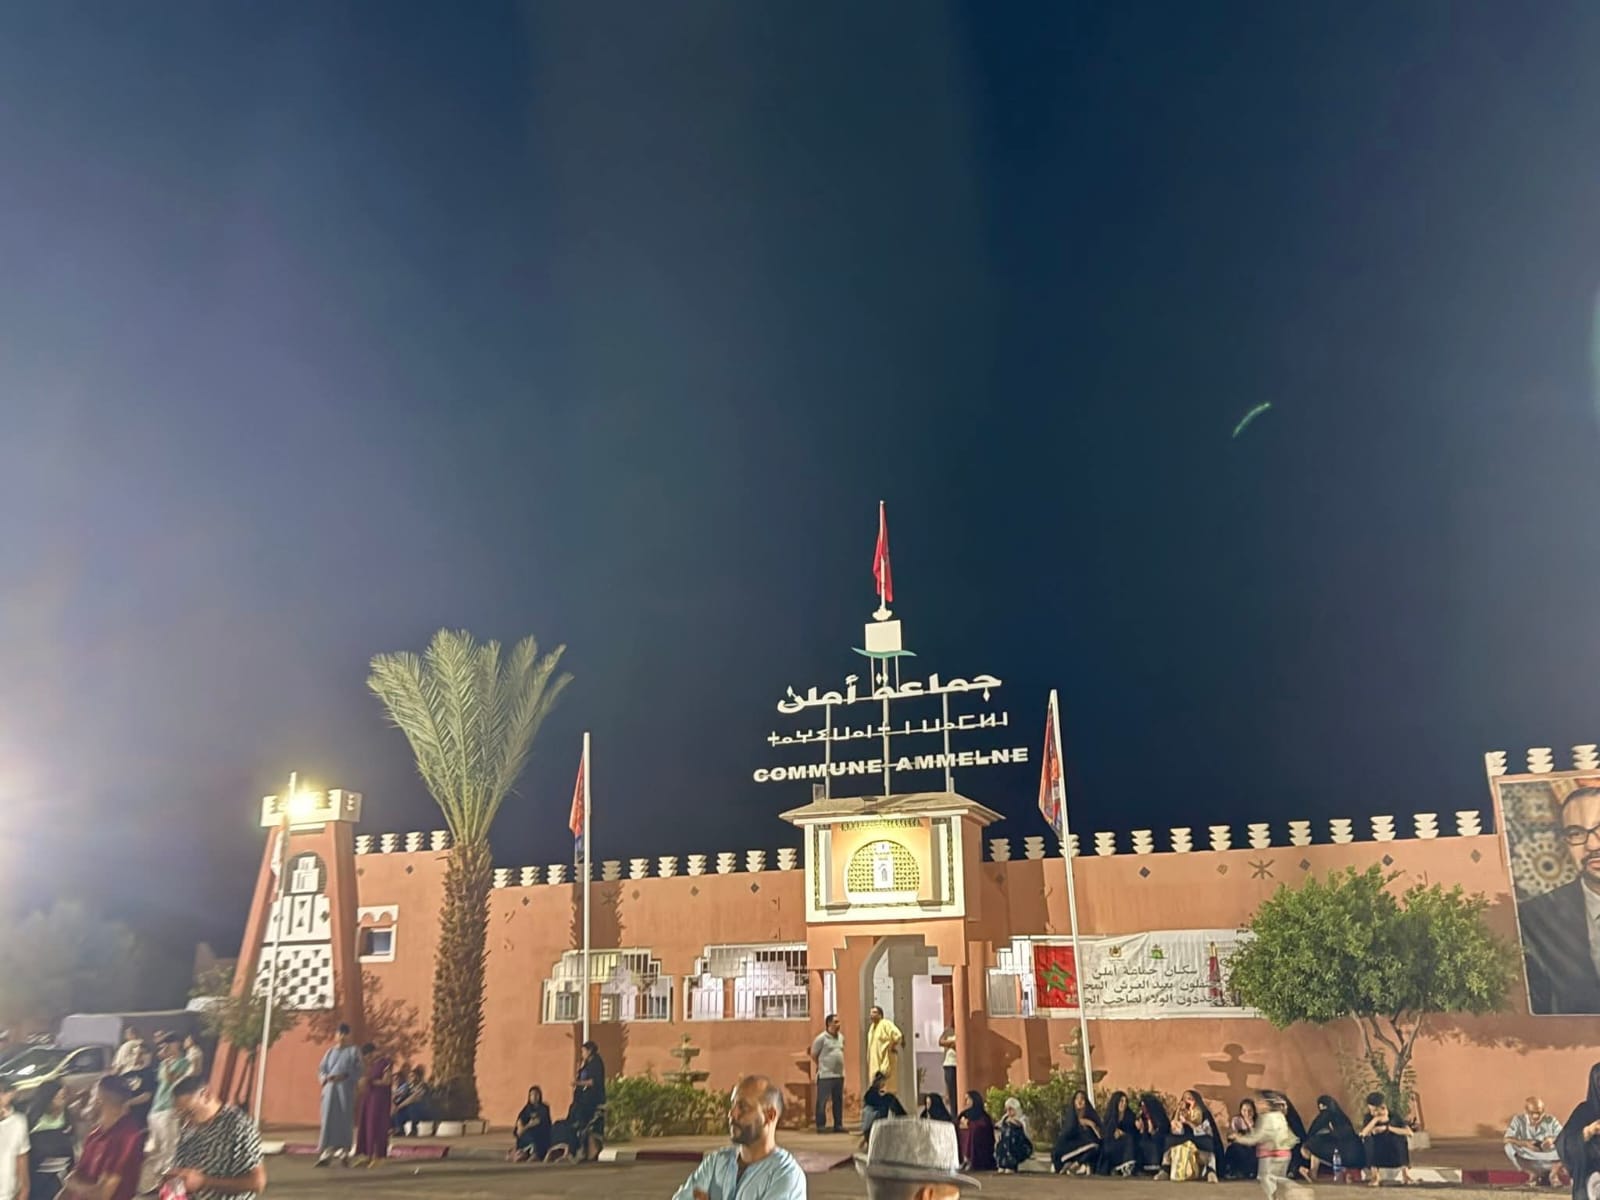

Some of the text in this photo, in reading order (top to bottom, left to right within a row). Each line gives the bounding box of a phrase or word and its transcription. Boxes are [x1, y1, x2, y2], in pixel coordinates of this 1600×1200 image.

[777, 672, 1002, 714] جماعة أملن
[752, 747, 1029, 783] COMMUNE AMMELNE
[1164, 964, 1197, 977] سكان
